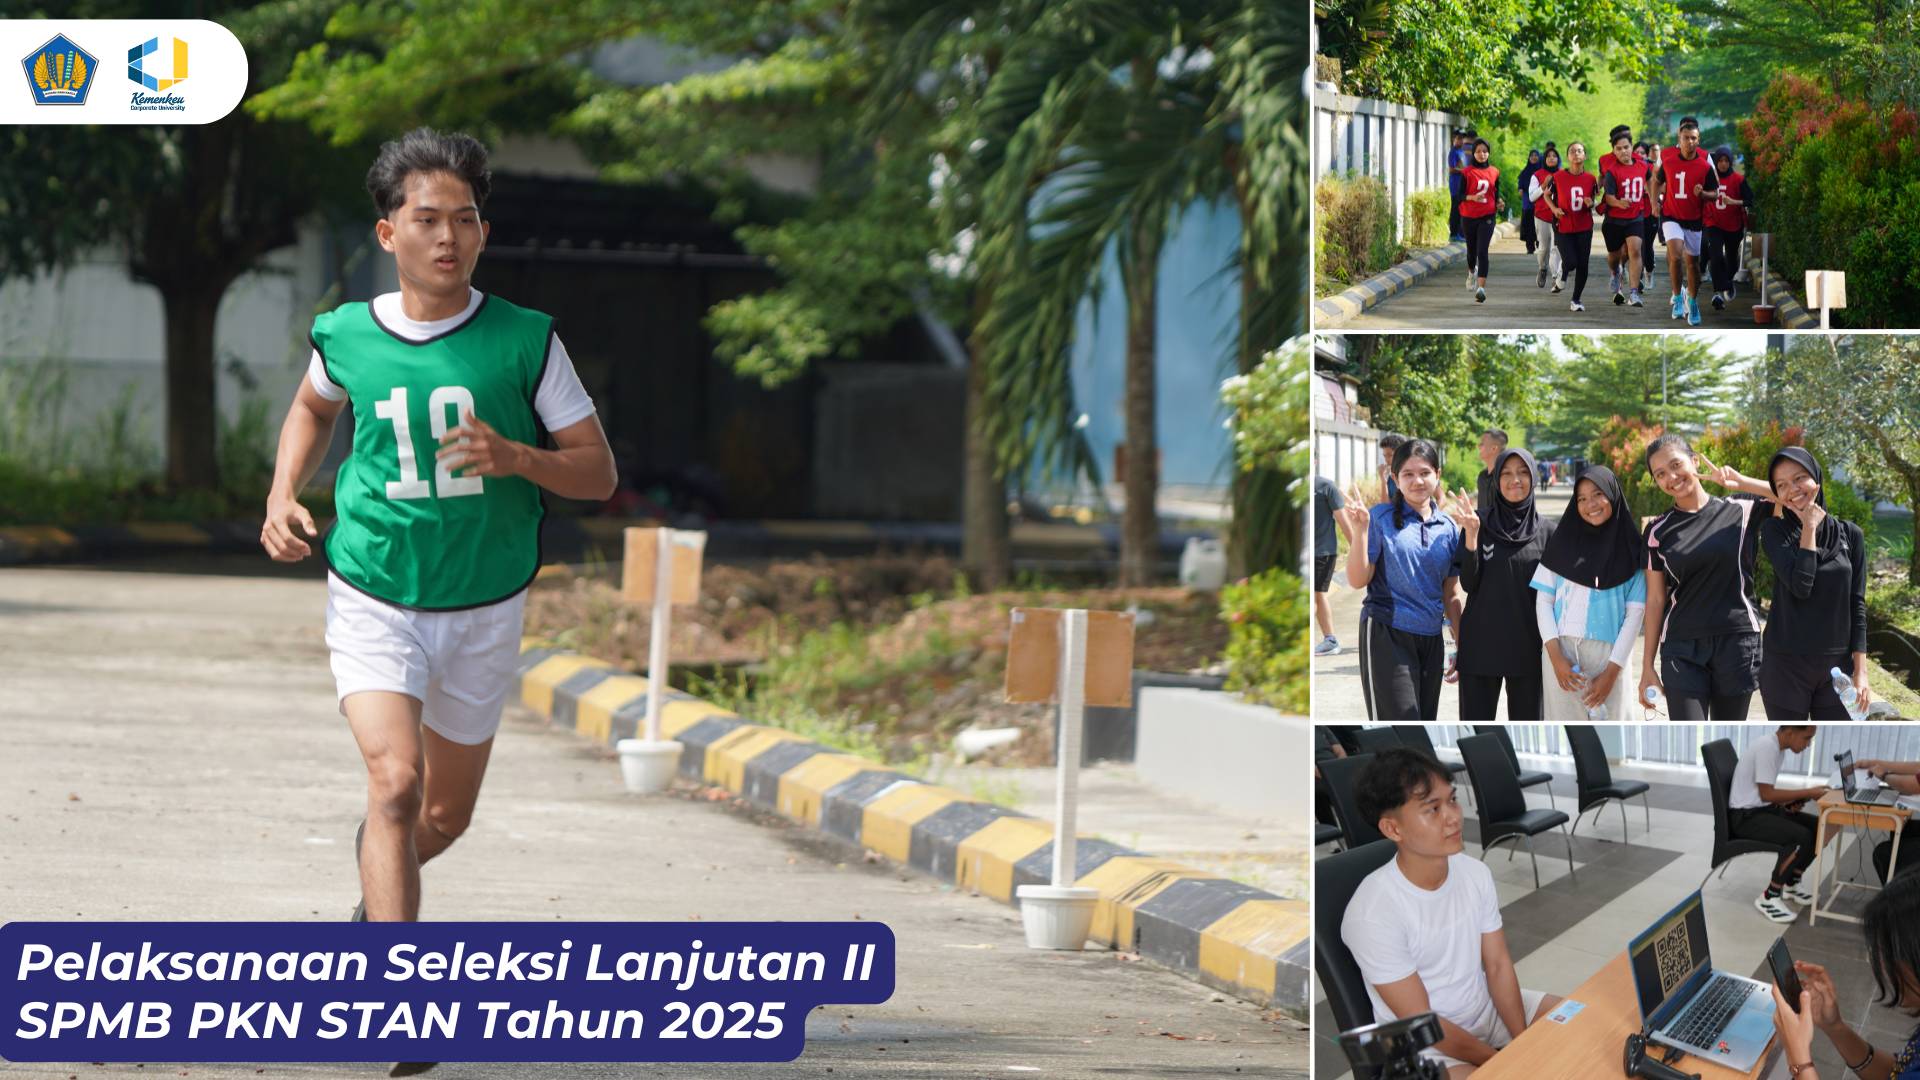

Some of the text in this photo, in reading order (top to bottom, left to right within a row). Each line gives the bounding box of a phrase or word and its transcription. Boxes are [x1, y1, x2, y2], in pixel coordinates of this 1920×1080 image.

[1476, 179, 1489, 203] 2
[1570, 186, 1584, 211] 6
[1621, 176, 1644, 203] 10
[1674, 171, 1688, 199] 1
[374, 385, 484, 500] 12
